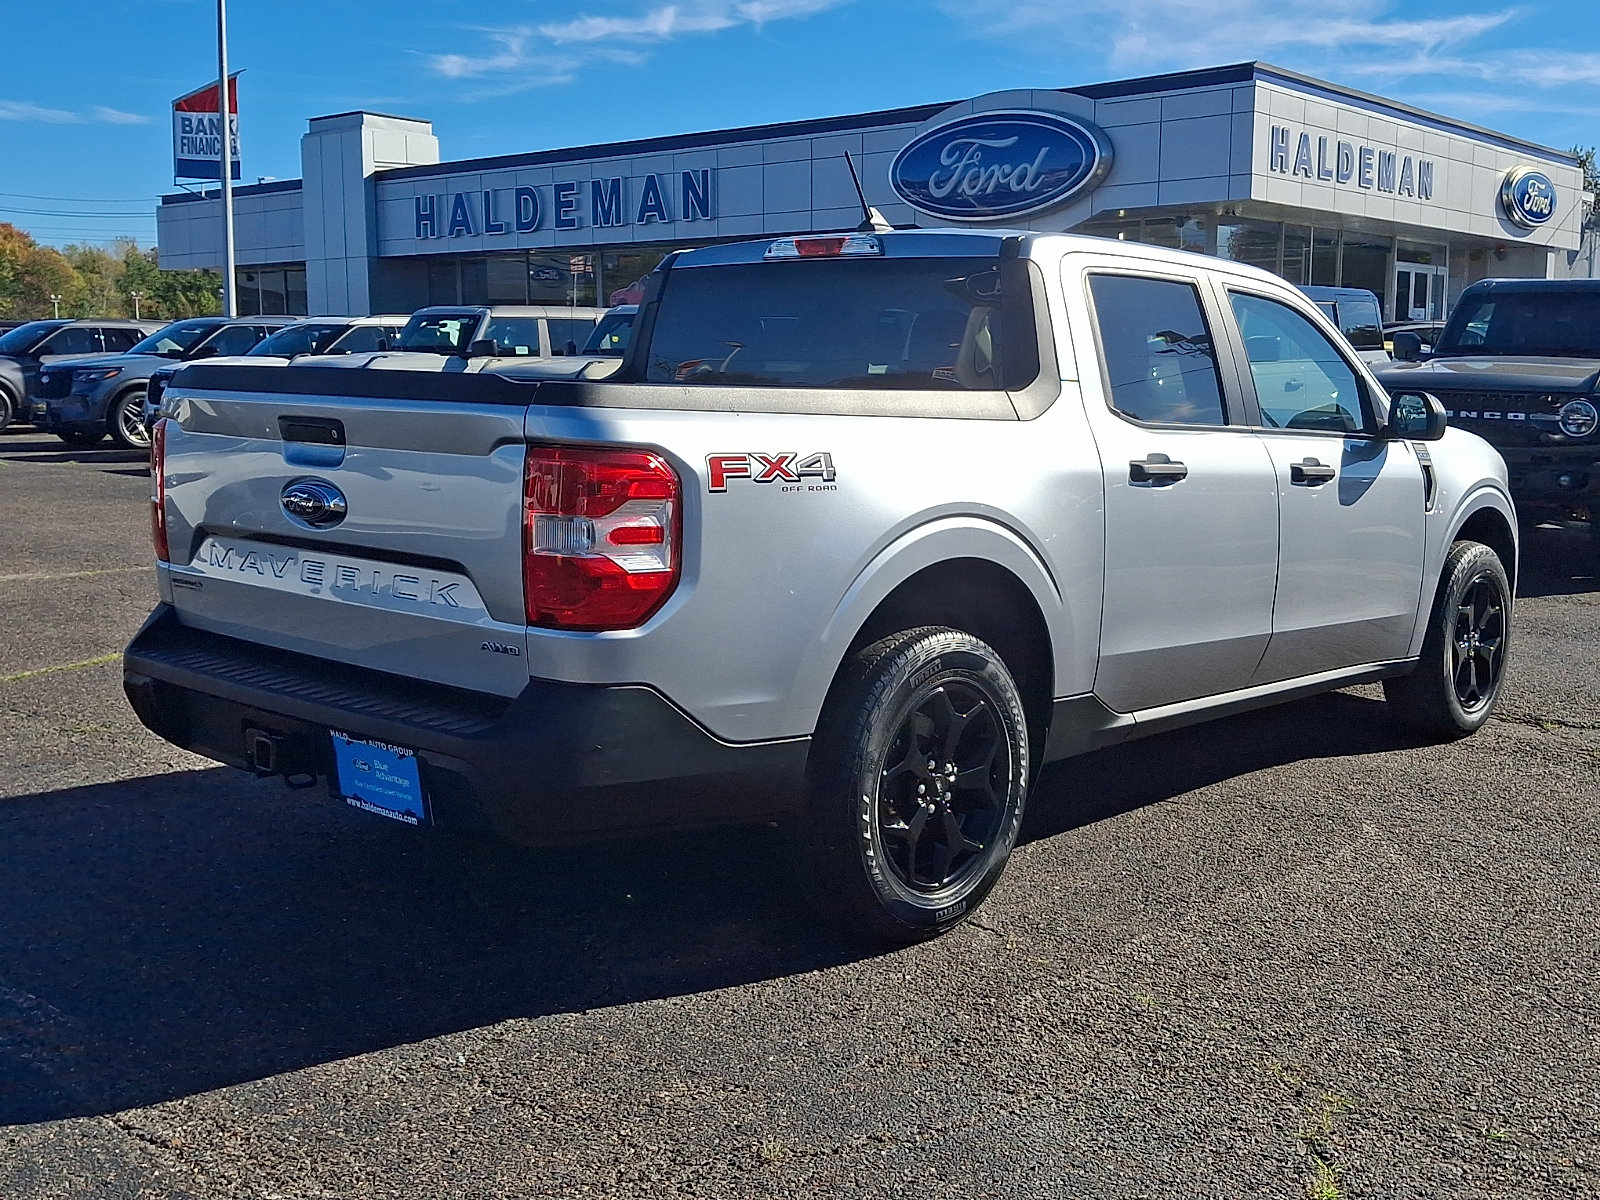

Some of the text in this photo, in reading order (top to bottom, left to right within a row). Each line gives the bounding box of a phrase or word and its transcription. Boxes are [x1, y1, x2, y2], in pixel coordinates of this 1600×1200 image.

[181, 117, 237, 136] BANK
[181, 136, 238, 156] FINANCG
[928, 136, 1050, 198] Ford
[1270, 125, 1433, 200] HALDEMAN
[414, 167, 714, 239] HALDEMAN
[1523, 179, 1552, 215] Ford
[705, 452, 837, 494] FX4
[781, 484, 838, 493] OFF ROAD
[209, 544, 461, 608] MAVERICK
[480, 640, 521, 657] AWD
[329, 729, 414, 757] HALDN AUTO GROUP
[375, 770, 410, 788] Advantage
[346, 797, 419, 826] www.haldemanauto.com
[935, 900, 967, 923] PIRELLI
